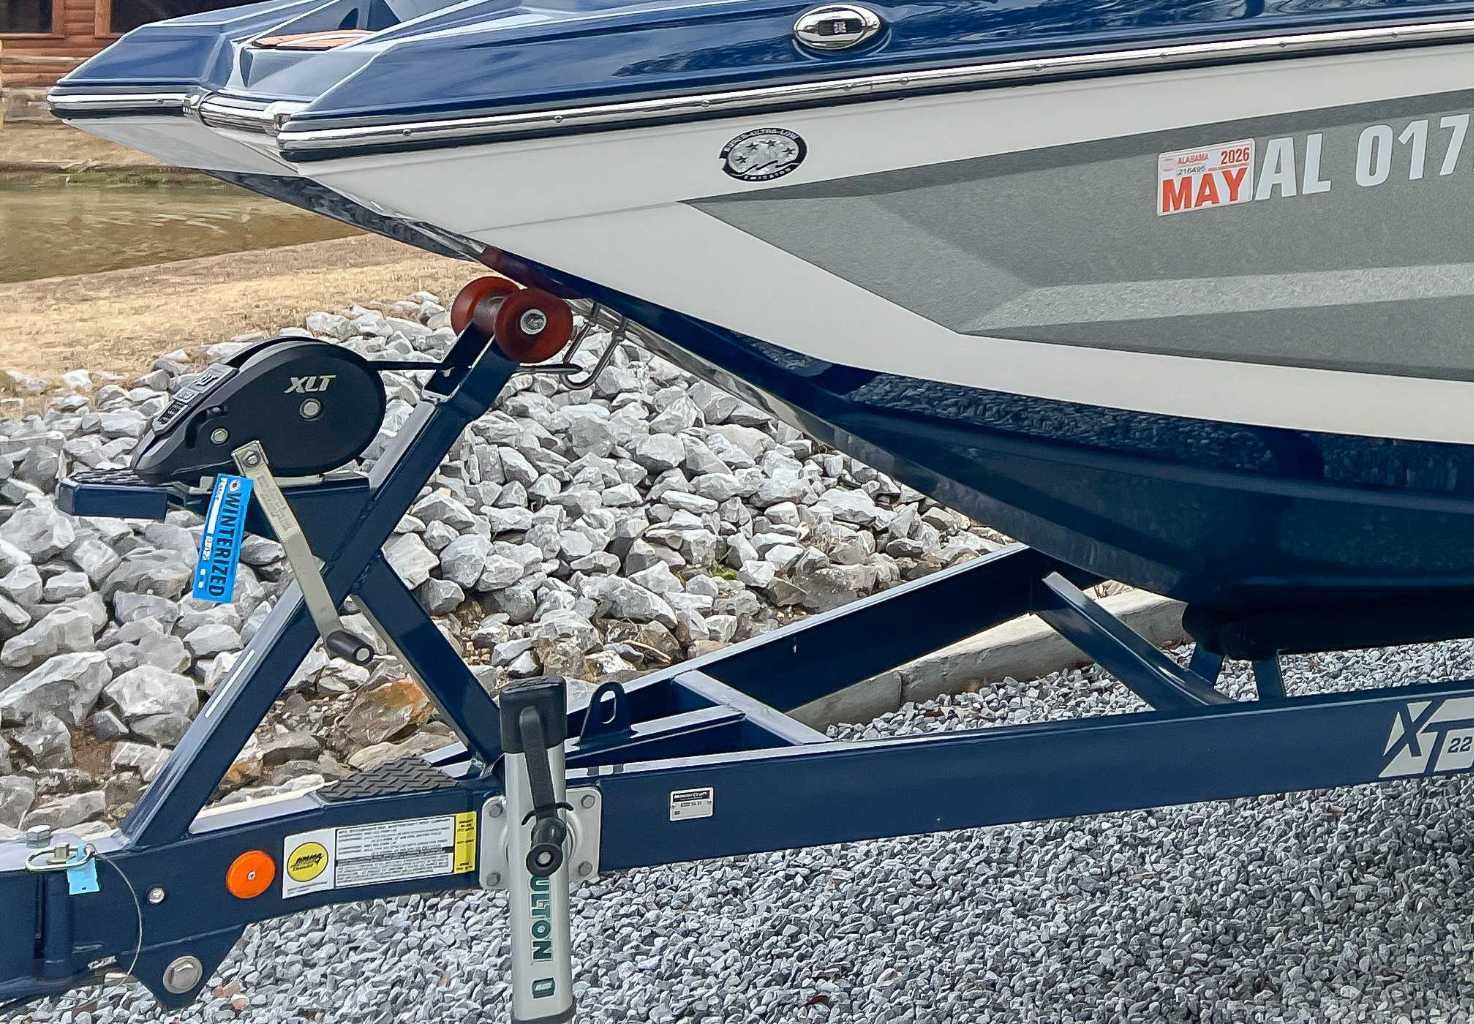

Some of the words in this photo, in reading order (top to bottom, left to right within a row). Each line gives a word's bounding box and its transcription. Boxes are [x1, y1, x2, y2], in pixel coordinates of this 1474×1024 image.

[1221, 147, 1250, 165] 2026
[1256, 133, 1331, 200] AL
[1162, 167, 1248, 212] MAY
[284, 375, 336, 393] XLT
[208, 494, 241, 597] WINTERIZED
[1447, 736, 1473, 754] 22
[529, 874, 552, 961] ULTON
